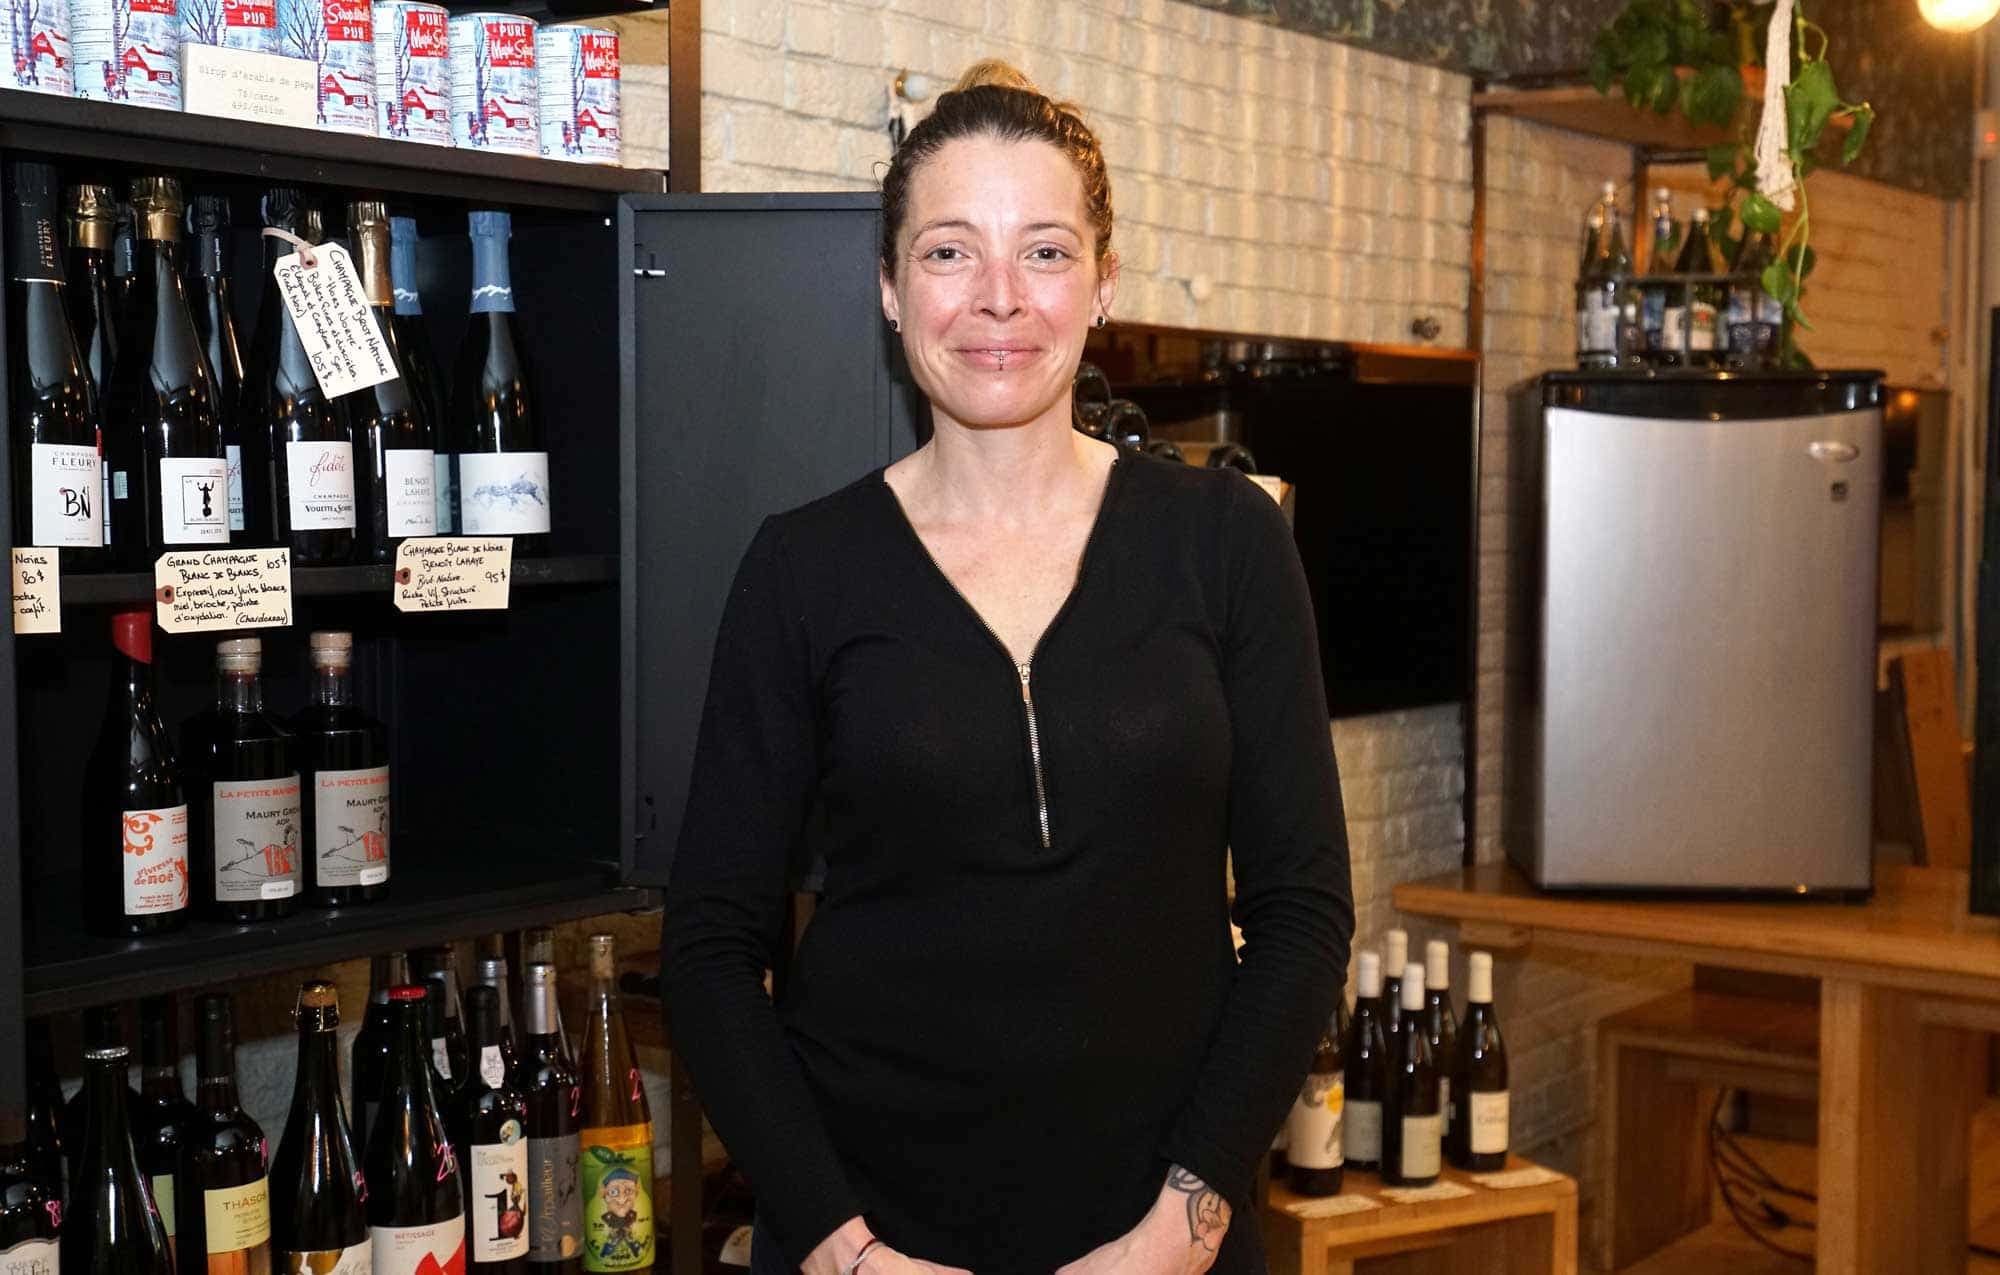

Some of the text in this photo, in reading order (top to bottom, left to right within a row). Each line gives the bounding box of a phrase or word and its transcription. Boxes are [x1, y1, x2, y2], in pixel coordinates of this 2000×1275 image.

[243, 12, 266, 25] PUR
[418, 13, 443, 26] PURE
[499, 24, 526, 37] PURE
[593, 36, 616, 49] PURE
[330, 250, 389, 376] CHAMPAGNE BRUT NATURE
[52, 457, 97, 468] FLEURY
[403, 544, 445, 557] CHAMPAGNE
[446, 542, 470, 556] BLANC
[167, 556, 200, 569] GRAND
[203, 553, 258, 567] CHAMPAGNE
[456, 556, 485, 567] LAHAYE
[21, 569, 45, 585] 80$
